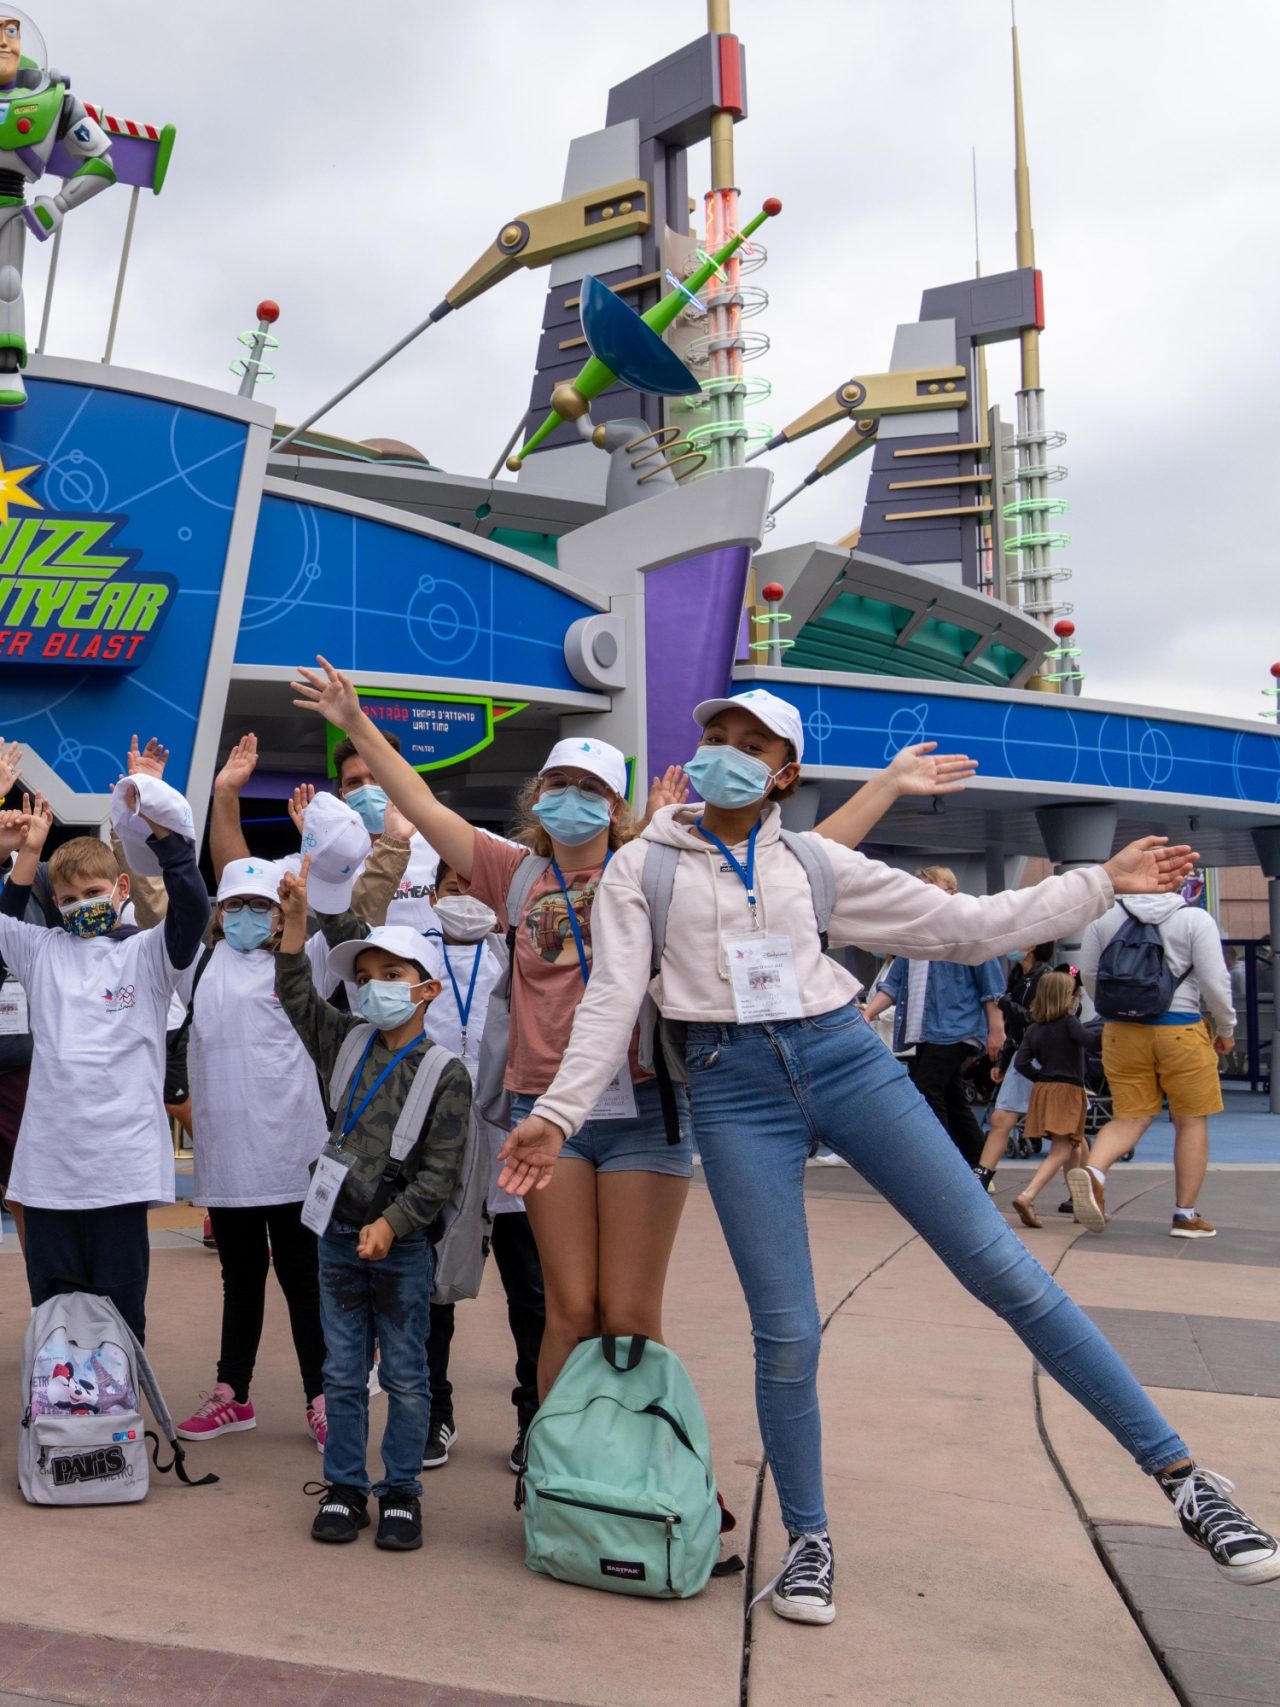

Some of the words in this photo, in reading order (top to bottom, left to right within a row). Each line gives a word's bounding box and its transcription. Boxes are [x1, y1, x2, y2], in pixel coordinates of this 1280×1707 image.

[41, 633, 145, 660] BLAST
[412, 721, 429, 731] WAIT
[322, 1504, 350, 1517] PUMA
[384, 1508, 413, 1521] PUMA
